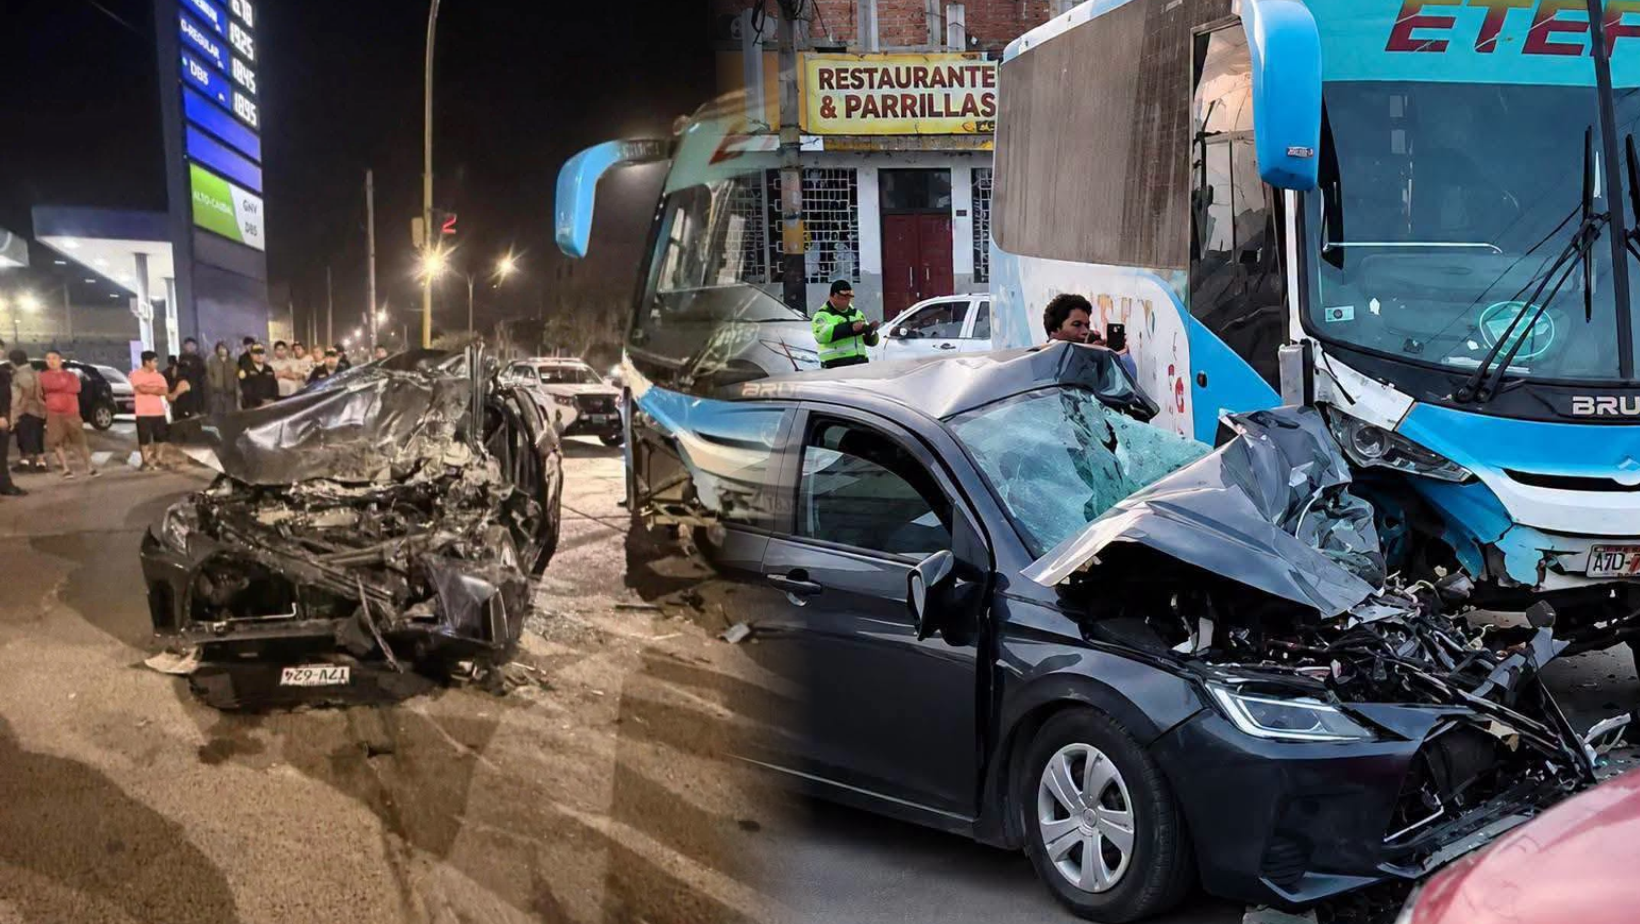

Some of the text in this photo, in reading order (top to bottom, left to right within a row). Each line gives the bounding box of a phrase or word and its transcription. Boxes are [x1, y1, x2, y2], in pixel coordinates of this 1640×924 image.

[232, 58, 256, 94] 1845
[819, 66, 995, 90] RESTAURANTE
[234, 92, 257, 126] 1895
[820, 93, 996, 119] & PARRILLAS
[243, 200, 257, 214] GNV
[1572, 396, 1640, 415] BRU
[284, 669, 346, 681] T7V-624
